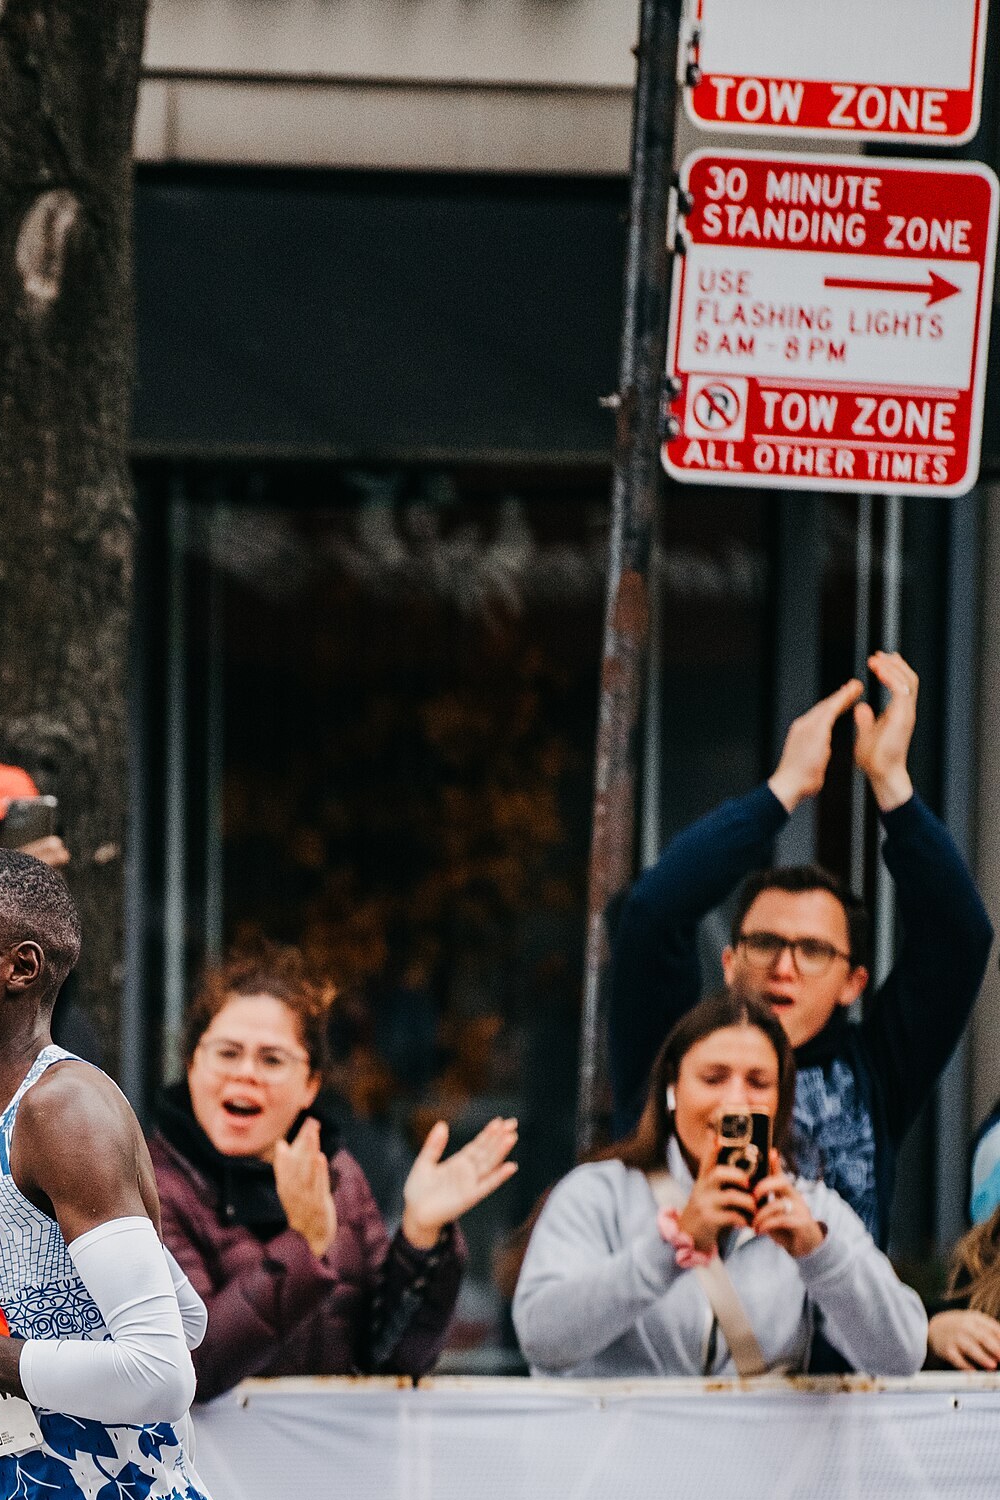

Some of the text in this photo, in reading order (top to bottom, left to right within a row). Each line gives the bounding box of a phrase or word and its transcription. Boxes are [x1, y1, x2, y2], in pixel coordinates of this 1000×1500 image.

[709, 76, 949, 133] TOW ZONE
[704, 165, 882, 212] 30 MINUTE
[701, 203, 973, 254] STANDING ZONE
[699, 270, 752, 295] USE
[695, 299, 945, 340] FLASHING LIGHTS
[759, 391, 957, 442] TOW ZONE
[682, 440, 949, 483] ALL OTHER TIMES
